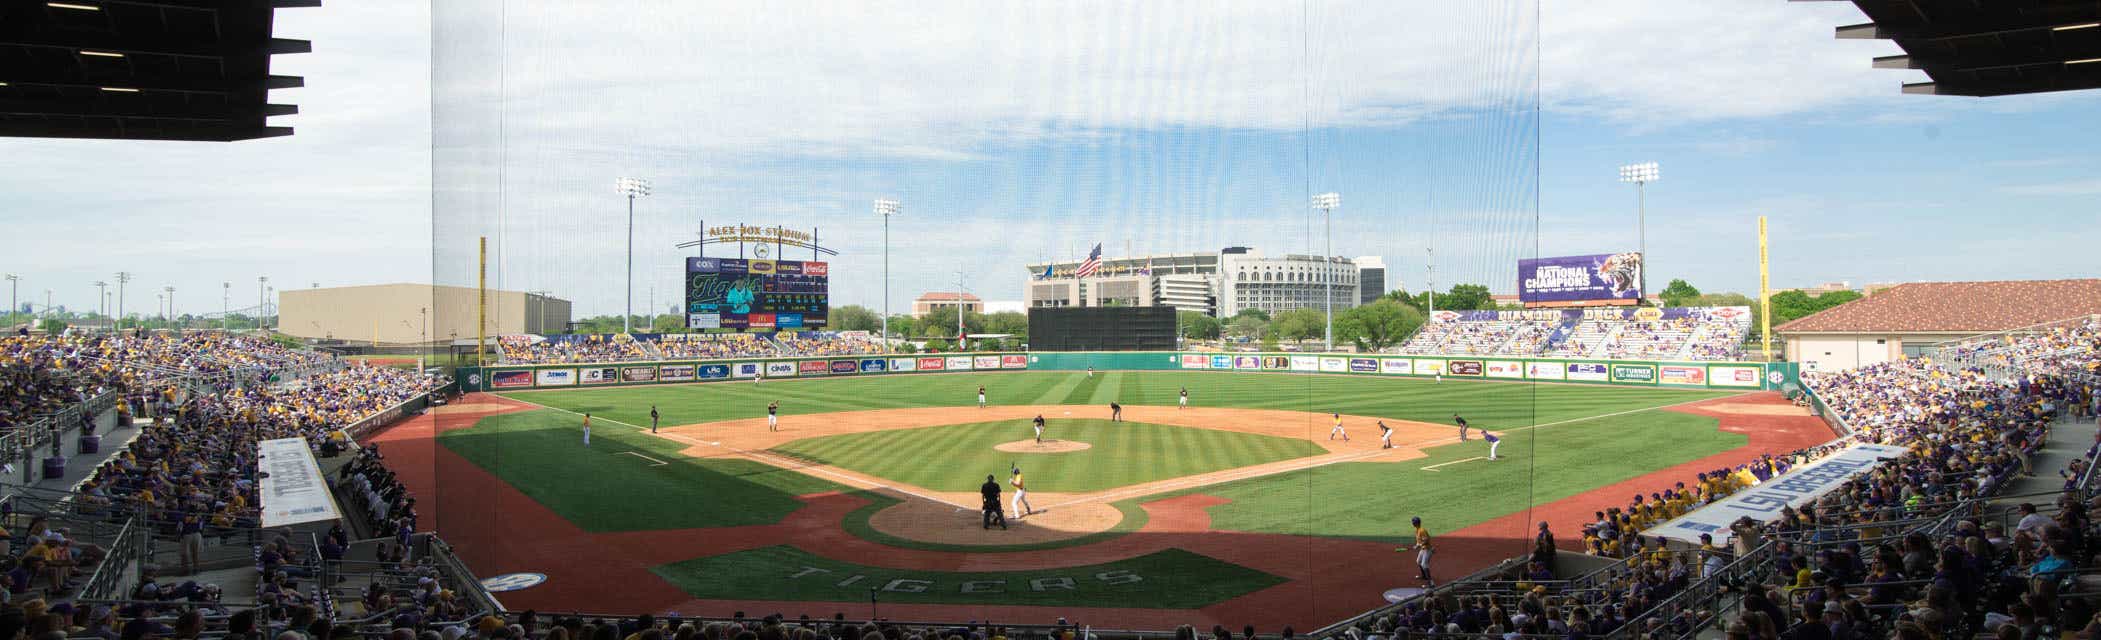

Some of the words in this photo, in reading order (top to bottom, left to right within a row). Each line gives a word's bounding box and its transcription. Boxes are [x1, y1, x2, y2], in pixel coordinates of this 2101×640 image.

[709, 226, 735, 236] ALEX
[741, 226, 760, 236] BOX
[765, 227, 810, 240] STADIUM
[696, 261, 714, 269] COX
[1536, 266, 1590, 280] NATIONAL
[1525, 277, 1591, 289] CHAMPIONS
[1498, 310, 1562, 320] DIAMOND
[1583, 308, 1624, 320] DECK
[1770, 459, 1873, 493] BASEBALL
[789, 566, 1143, 593] TIGERS
